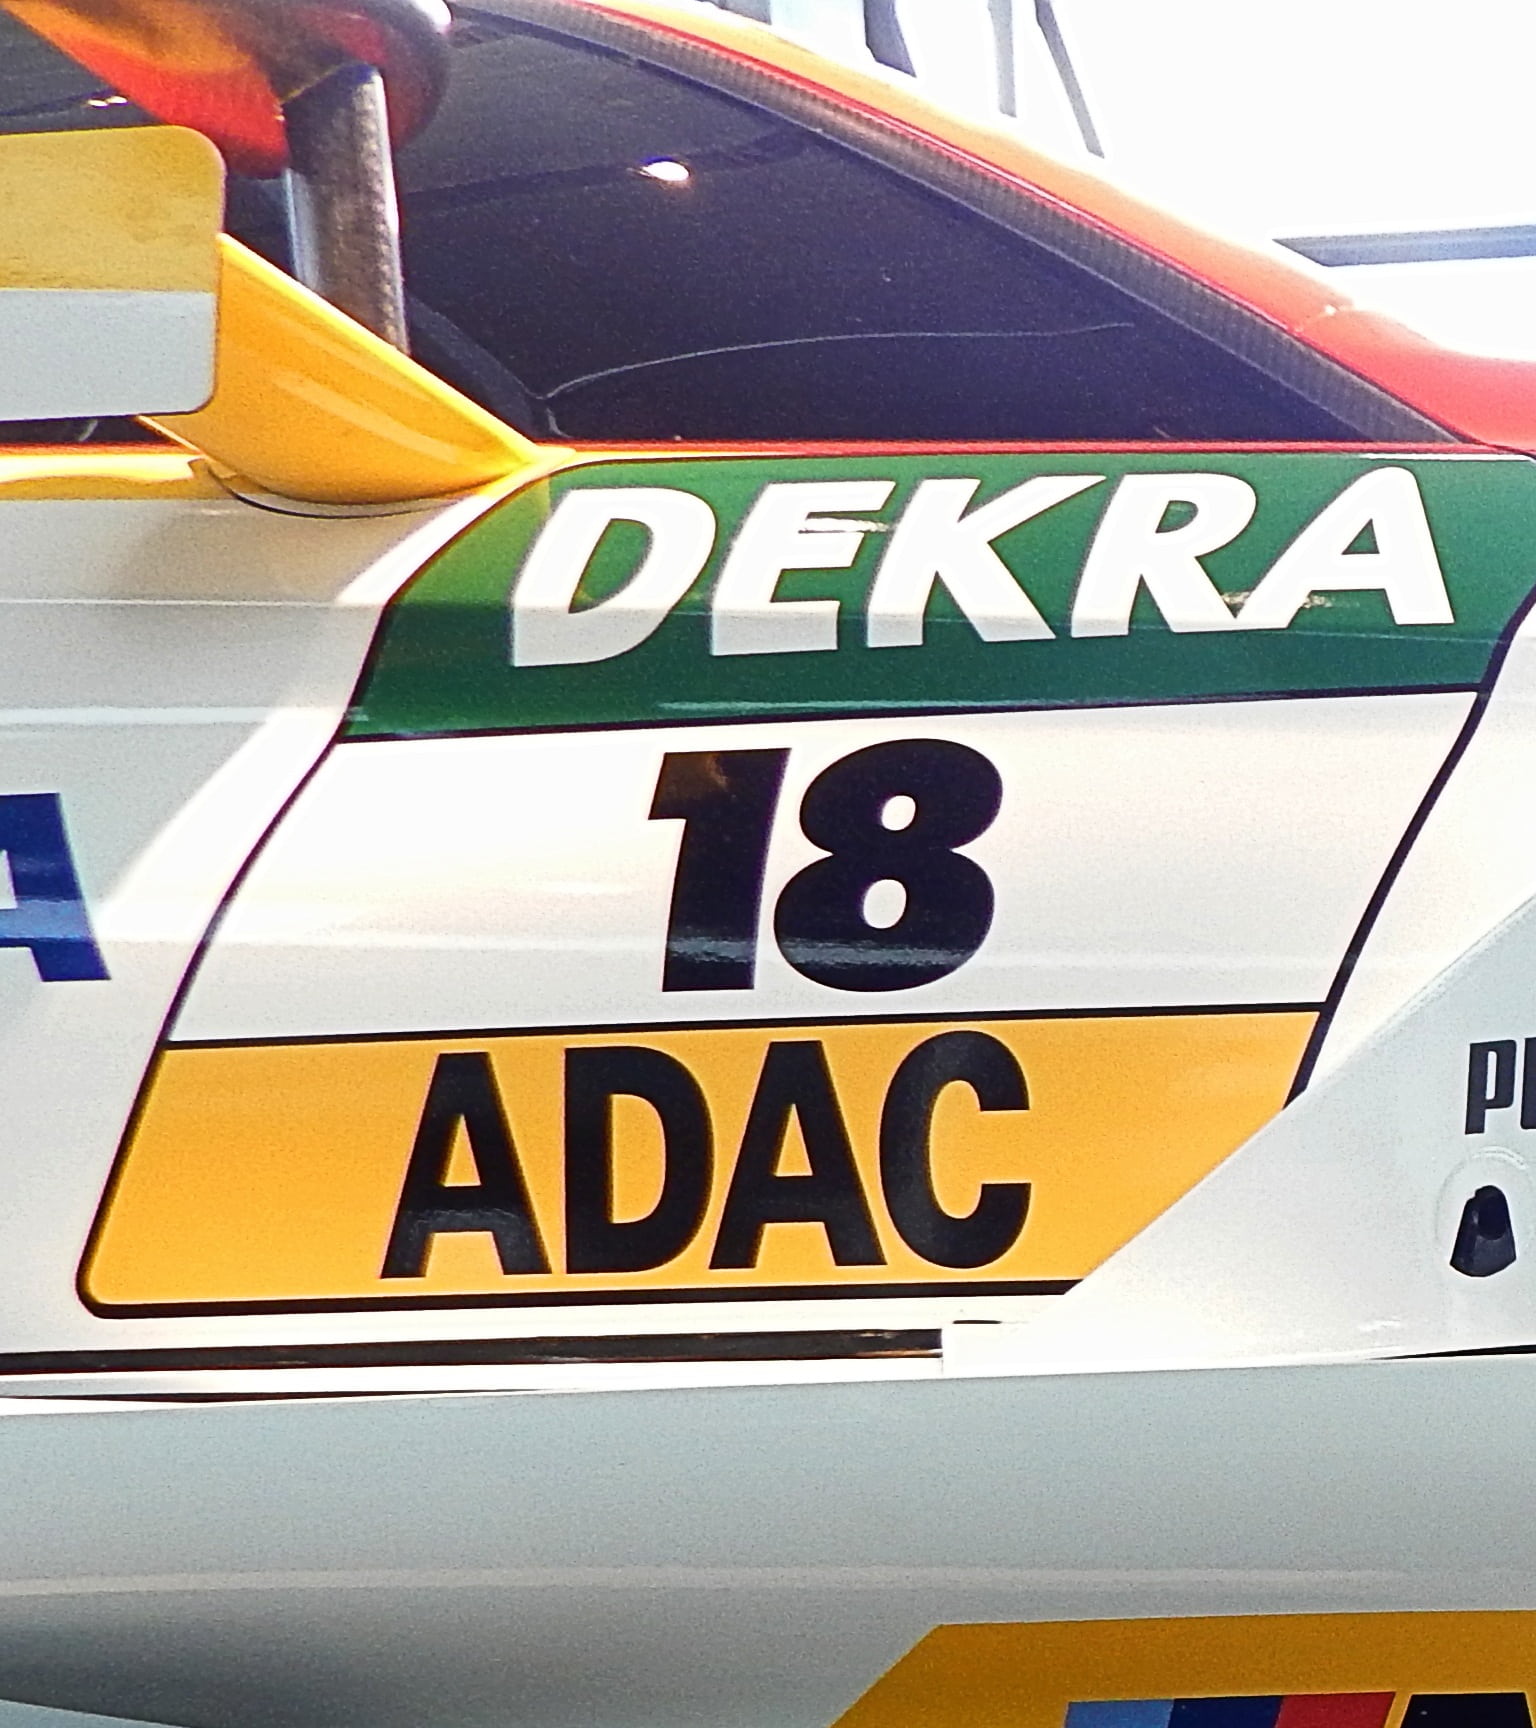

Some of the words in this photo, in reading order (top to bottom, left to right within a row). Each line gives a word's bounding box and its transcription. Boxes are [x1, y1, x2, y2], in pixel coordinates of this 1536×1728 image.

[511, 467, 1454, 667] DEKRA
[647, 738, 1003, 993] 18
[380, 1031, 1032, 1279] ADAC
